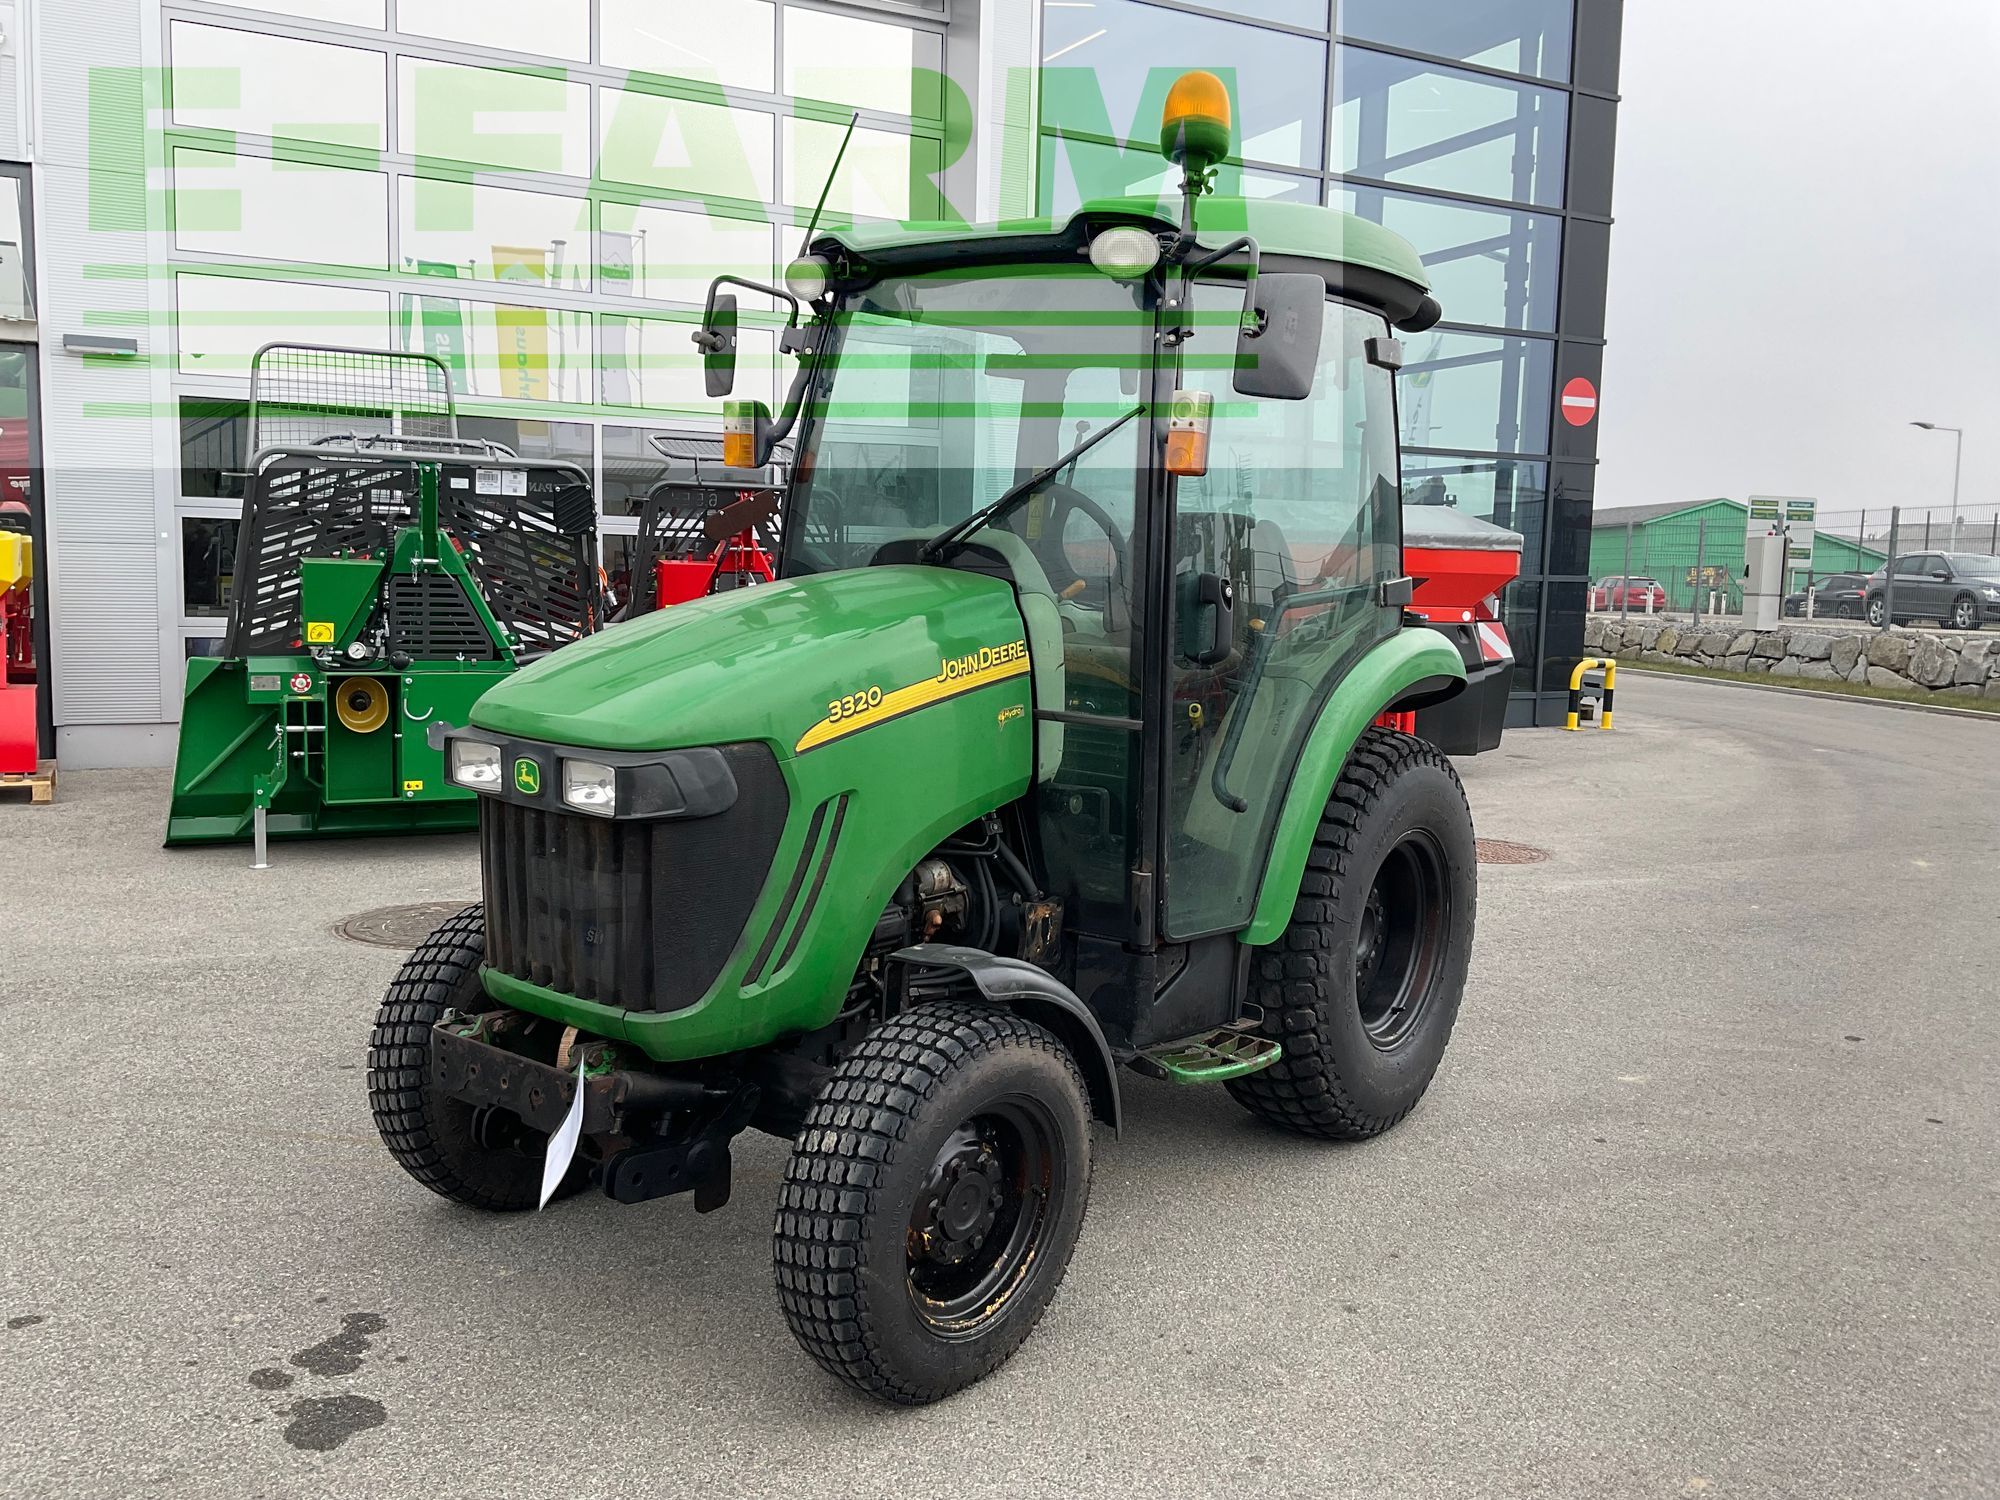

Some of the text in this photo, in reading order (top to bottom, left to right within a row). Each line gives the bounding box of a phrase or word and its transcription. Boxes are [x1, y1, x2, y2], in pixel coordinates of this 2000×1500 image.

[938, 639, 1025, 682] JOHN DEERE
[828, 685, 882, 722] 3320
